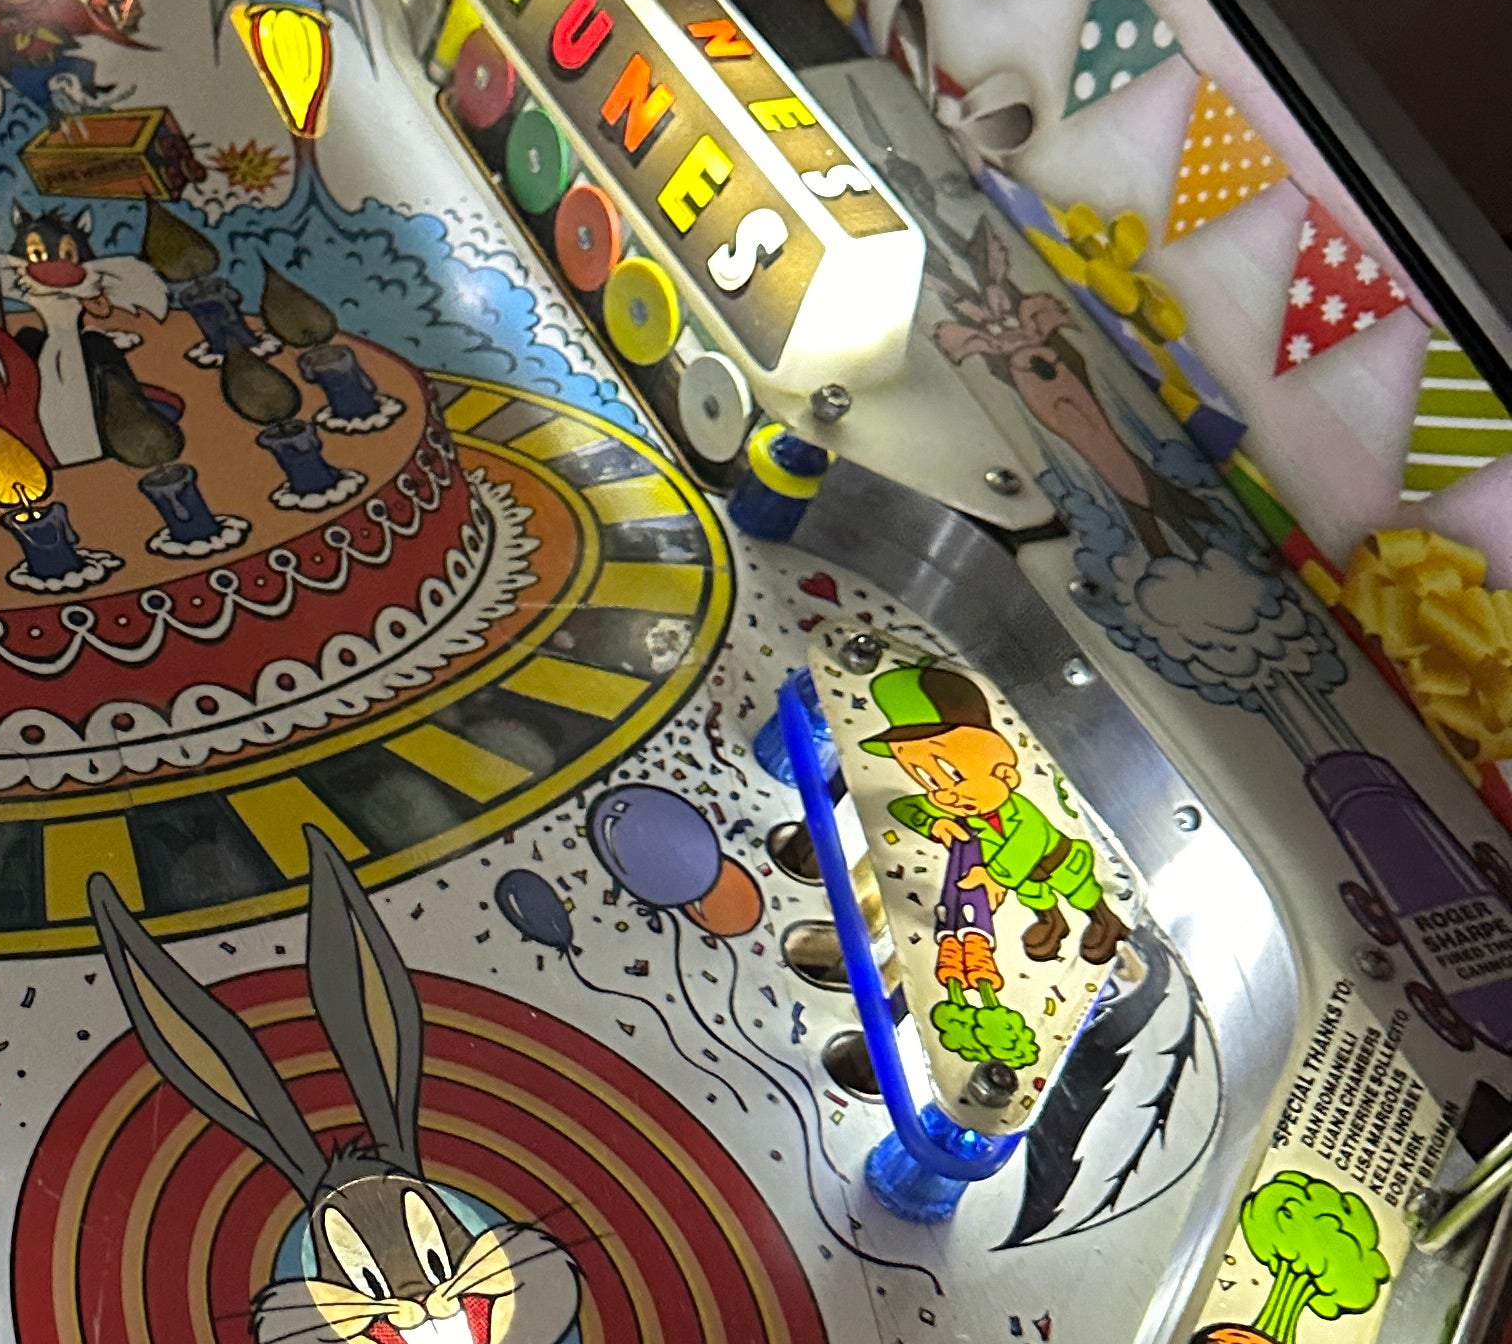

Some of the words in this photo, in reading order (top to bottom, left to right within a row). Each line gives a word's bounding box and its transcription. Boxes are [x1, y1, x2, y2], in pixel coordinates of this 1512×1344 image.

[1414, 902, 1492, 932] ROGER
[1303, 1003, 1343, 1073] THANKS
[1301, 1111, 1325, 1148] DAN
[1318, 1031, 1358, 1112] ROMANELLI
[1317, 1107, 1348, 1159] LUANA
[1344, 1026, 1381, 1106] CHAMBERS
[1336, 1084, 1378, 1170] CATHERINE
[1351, 1143, 1376, 1183] LISA
[1368, 1069, 1407, 1145] MARGOLIS
[1369, 1143, 1399, 1195] KELLY
[1391, 1079, 1426, 1146] LINDSEY
[1385, 1171, 1407, 1207] BOB
[1399, 1131, 1426, 1173] KIRK
[1417, 1100, 1460, 1181] BERGMAN
